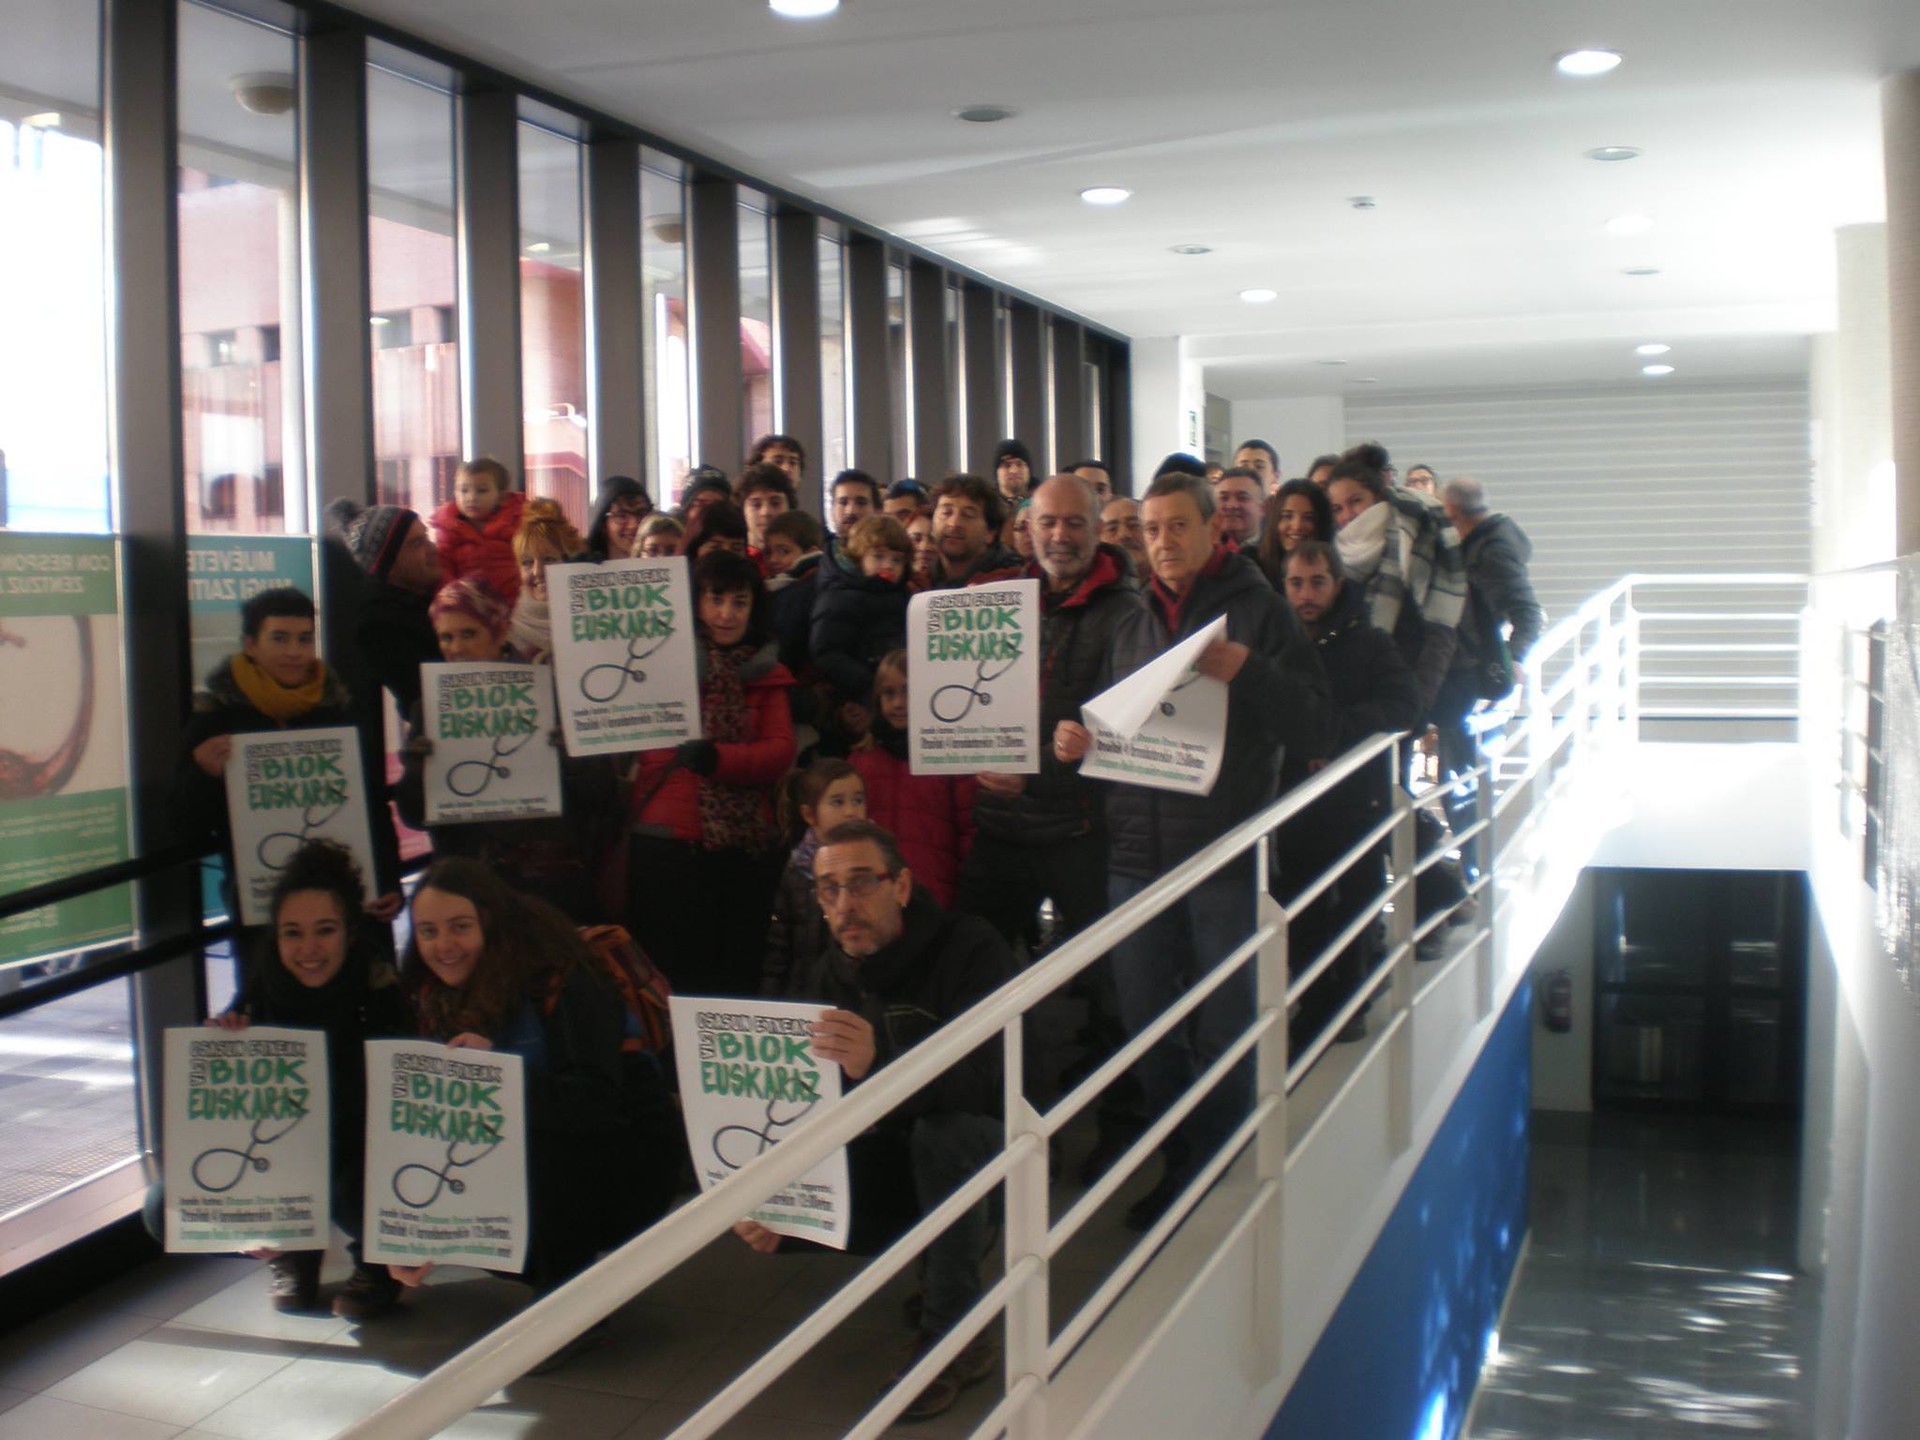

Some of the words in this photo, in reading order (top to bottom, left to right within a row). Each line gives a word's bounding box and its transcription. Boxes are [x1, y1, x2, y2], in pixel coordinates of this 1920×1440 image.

[585, 584, 673, 611] BIOK
[571, 609, 676, 643] EUSKARAZ
[943, 607, 1022, 632] BIOK
[927, 632, 1024, 663] EUSKARAZ
[453, 683, 536, 710] BIOK
[262, 753, 345, 780] BIOK
[247, 778, 349, 812] EUSKARAZ
[716, 1032, 817, 1067] BIOK
[210, 1058, 307, 1085] BIOK
[701, 1061, 823, 1103] EUSKARAZ
[188, 1086, 310, 1120] EUSKARAZ
[411, 1072, 503, 1112] BIOK
[390, 1100, 506, 1145] EUSKARAZ
